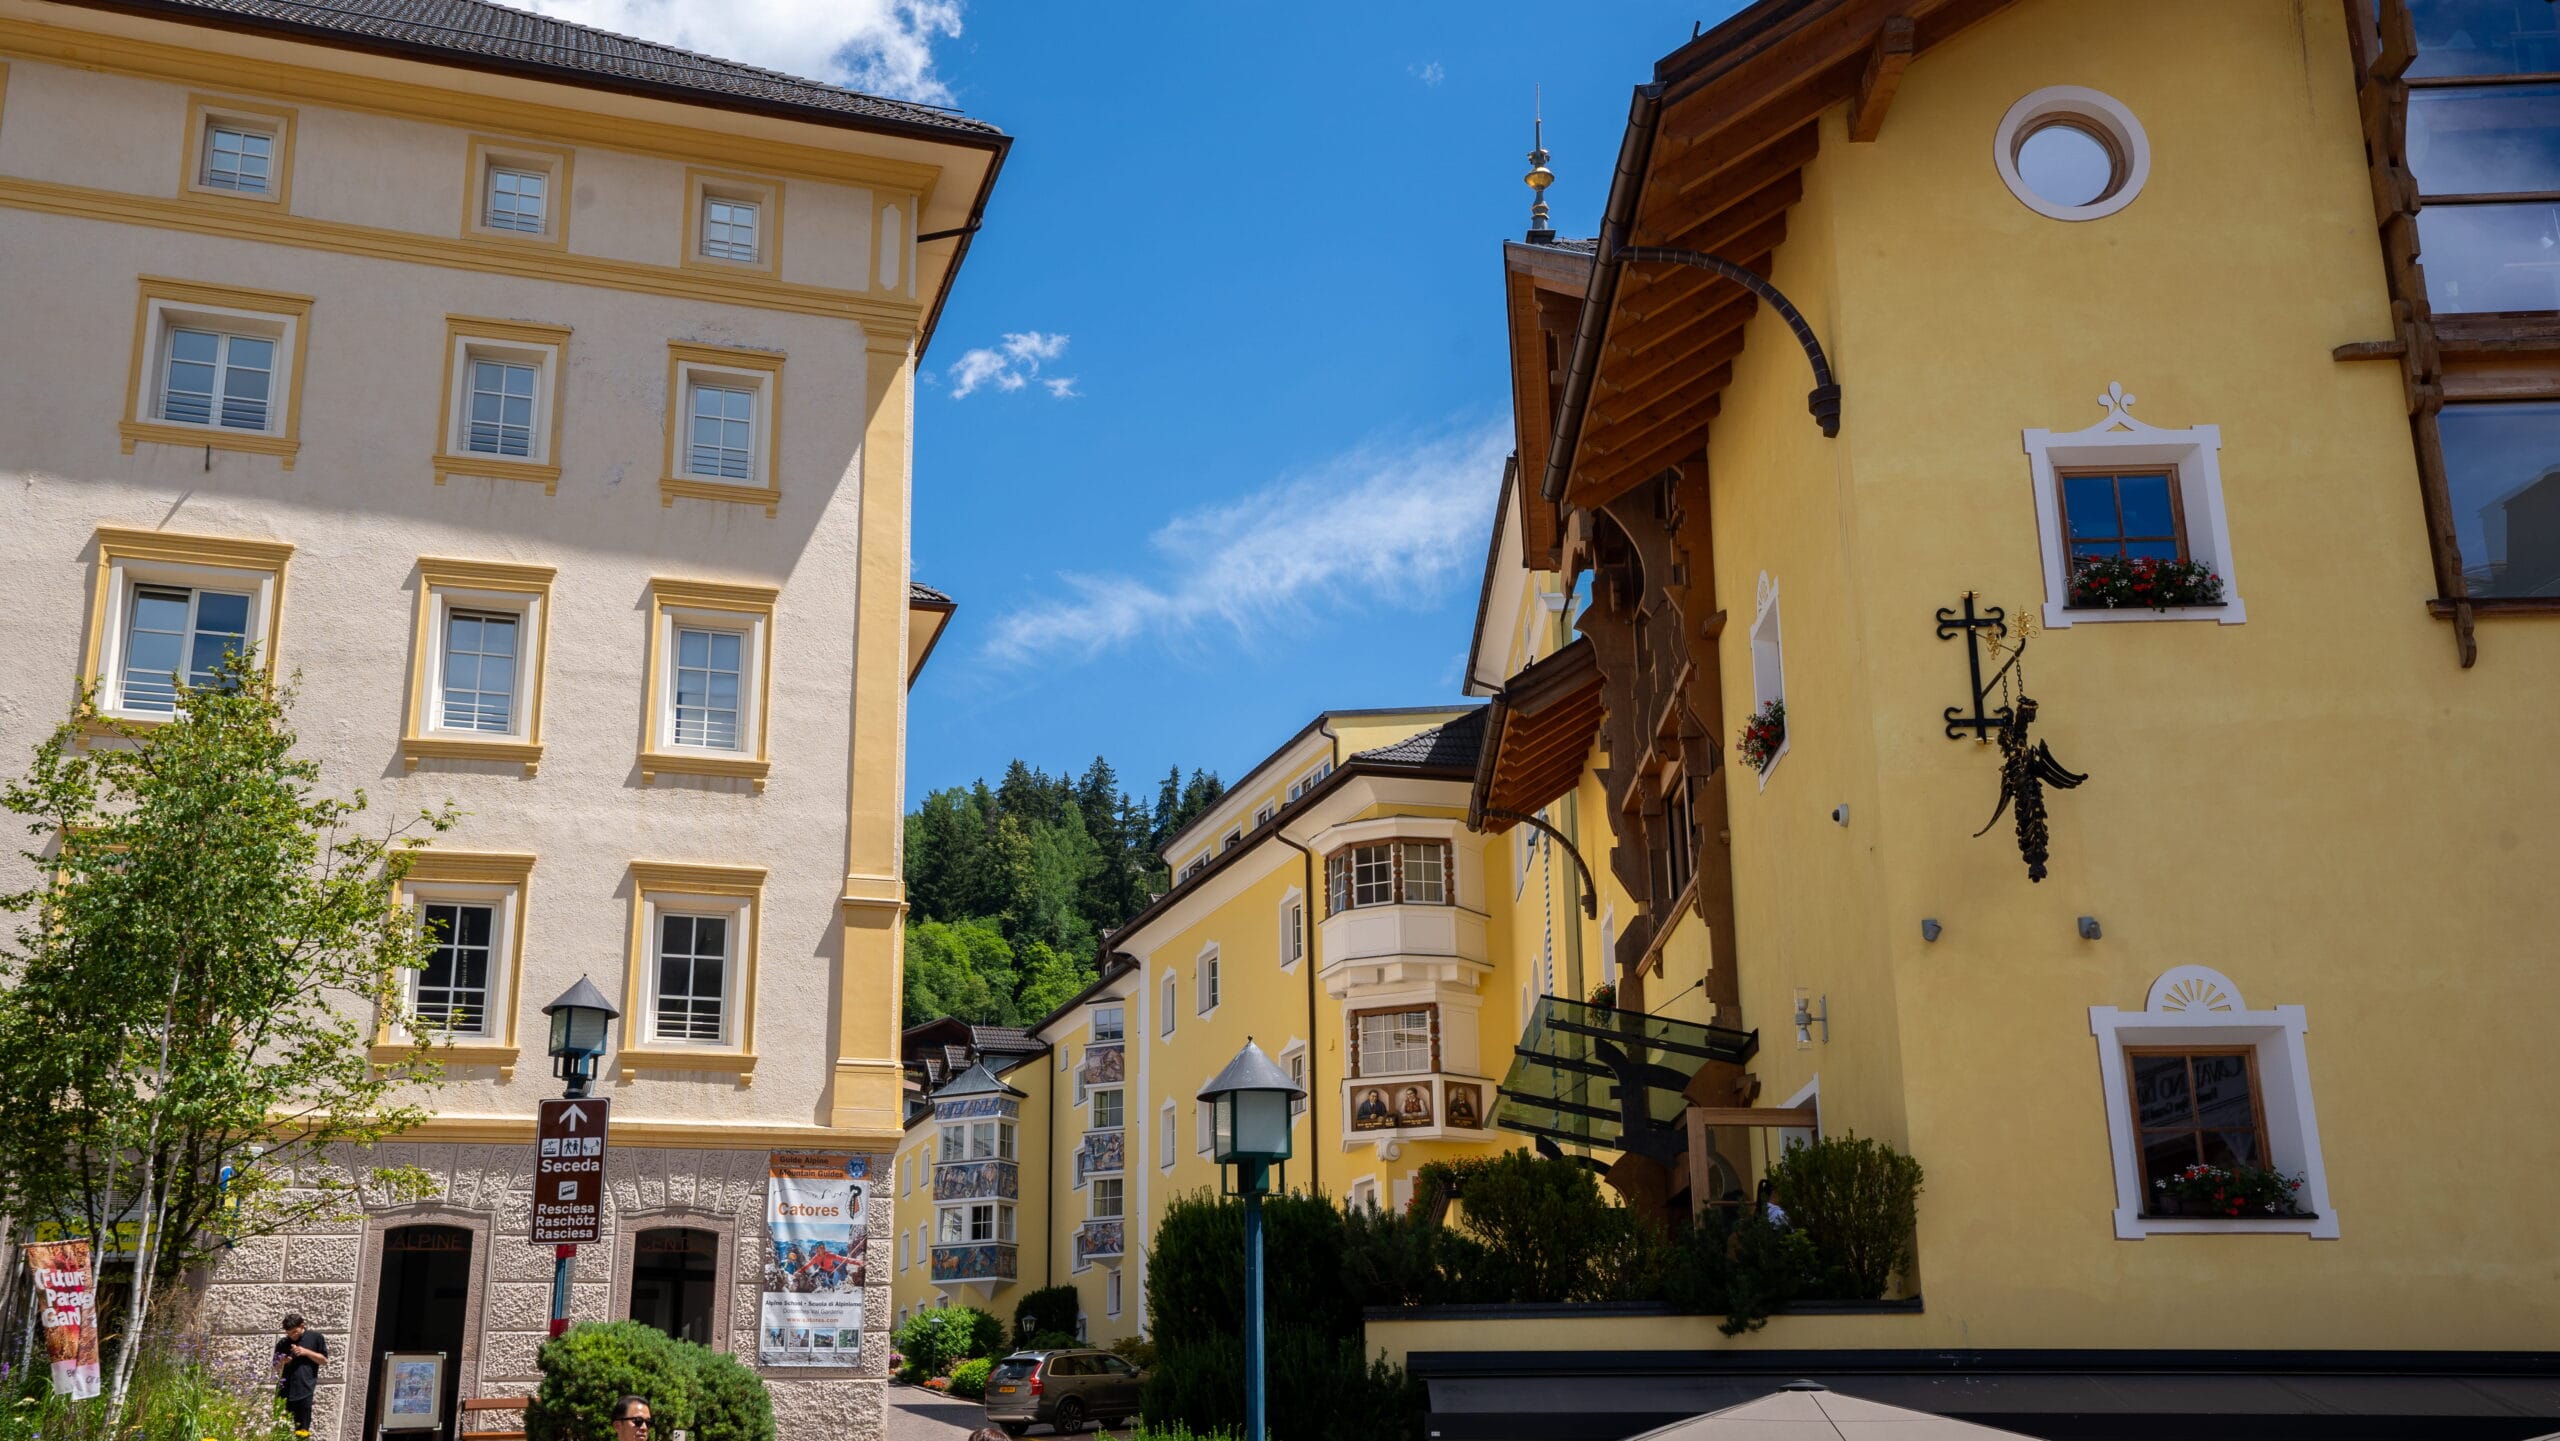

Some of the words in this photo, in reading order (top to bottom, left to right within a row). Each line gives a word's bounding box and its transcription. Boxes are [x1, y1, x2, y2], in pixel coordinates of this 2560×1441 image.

[541, 1158, 600, 1173] Seceda
[780, 1156, 801, 1164] Guide
[805, 1157, 829, 1165] Alpine
[780, 1169, 815, 1177] Mountain
[818, 1170, 843, 1178] Guides
[538, 1203, 595, 1214] Resciesa
[778, 1202, 839, 1217] Catores
[535, 1215, 596, 1227] Raschötz
[535, 1227, 593, 1240] Rasciesa
[391, 1231, 465, 1249] ALPINE
